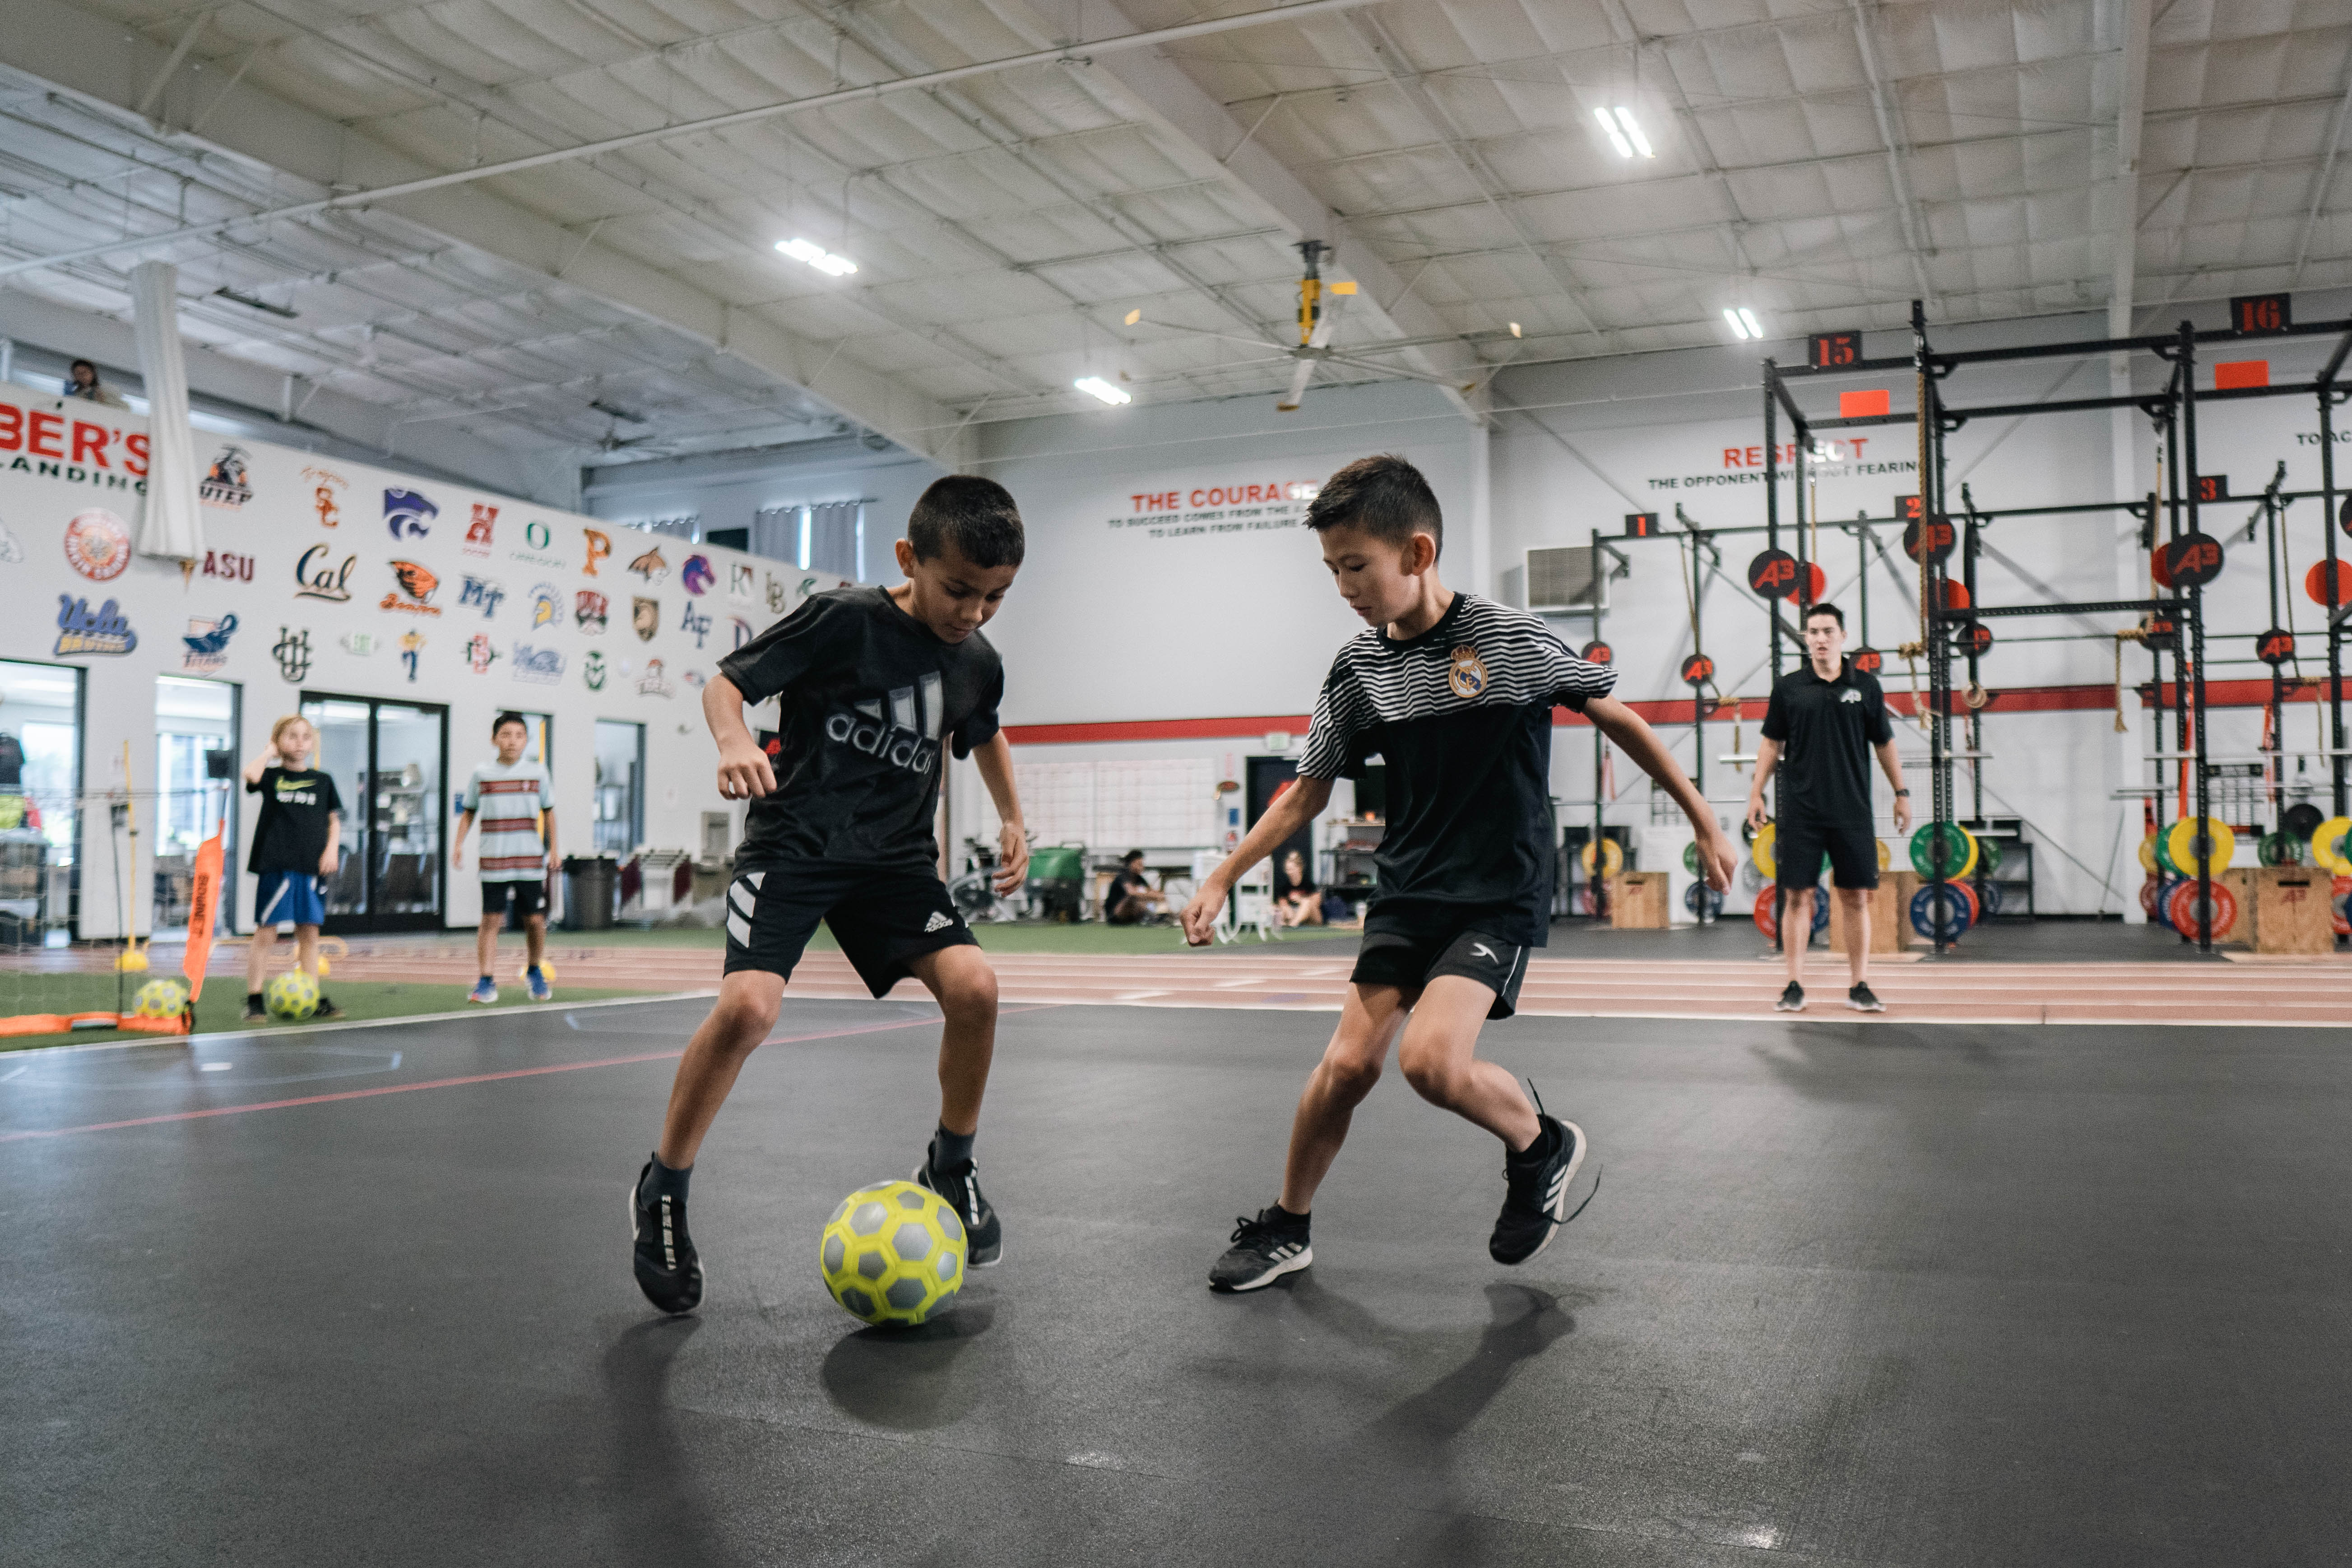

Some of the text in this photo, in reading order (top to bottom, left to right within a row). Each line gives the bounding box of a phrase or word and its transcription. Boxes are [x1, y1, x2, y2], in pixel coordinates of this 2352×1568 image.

[2242, 297, 2281, 332] 16
[1819, 336, 1854, 366] 15
[2296, 433, 2321, 446] TO
[0, 456, 148, 496] ANDING
[1649, 478, 1679, 490] THE
[1857, 461, 1917, 475] FEARIN
[2201, 478, 2217, 500] 3
[1131, 491, 1181, 513] THE
[1906, 497, 1921, 518] 2
[1637, 516, 1647, 536] 1
[203, 550, 255, 583] ASU
[296, 542, 357, 593] Cal
[1754, 558, 1795, 589] A3
